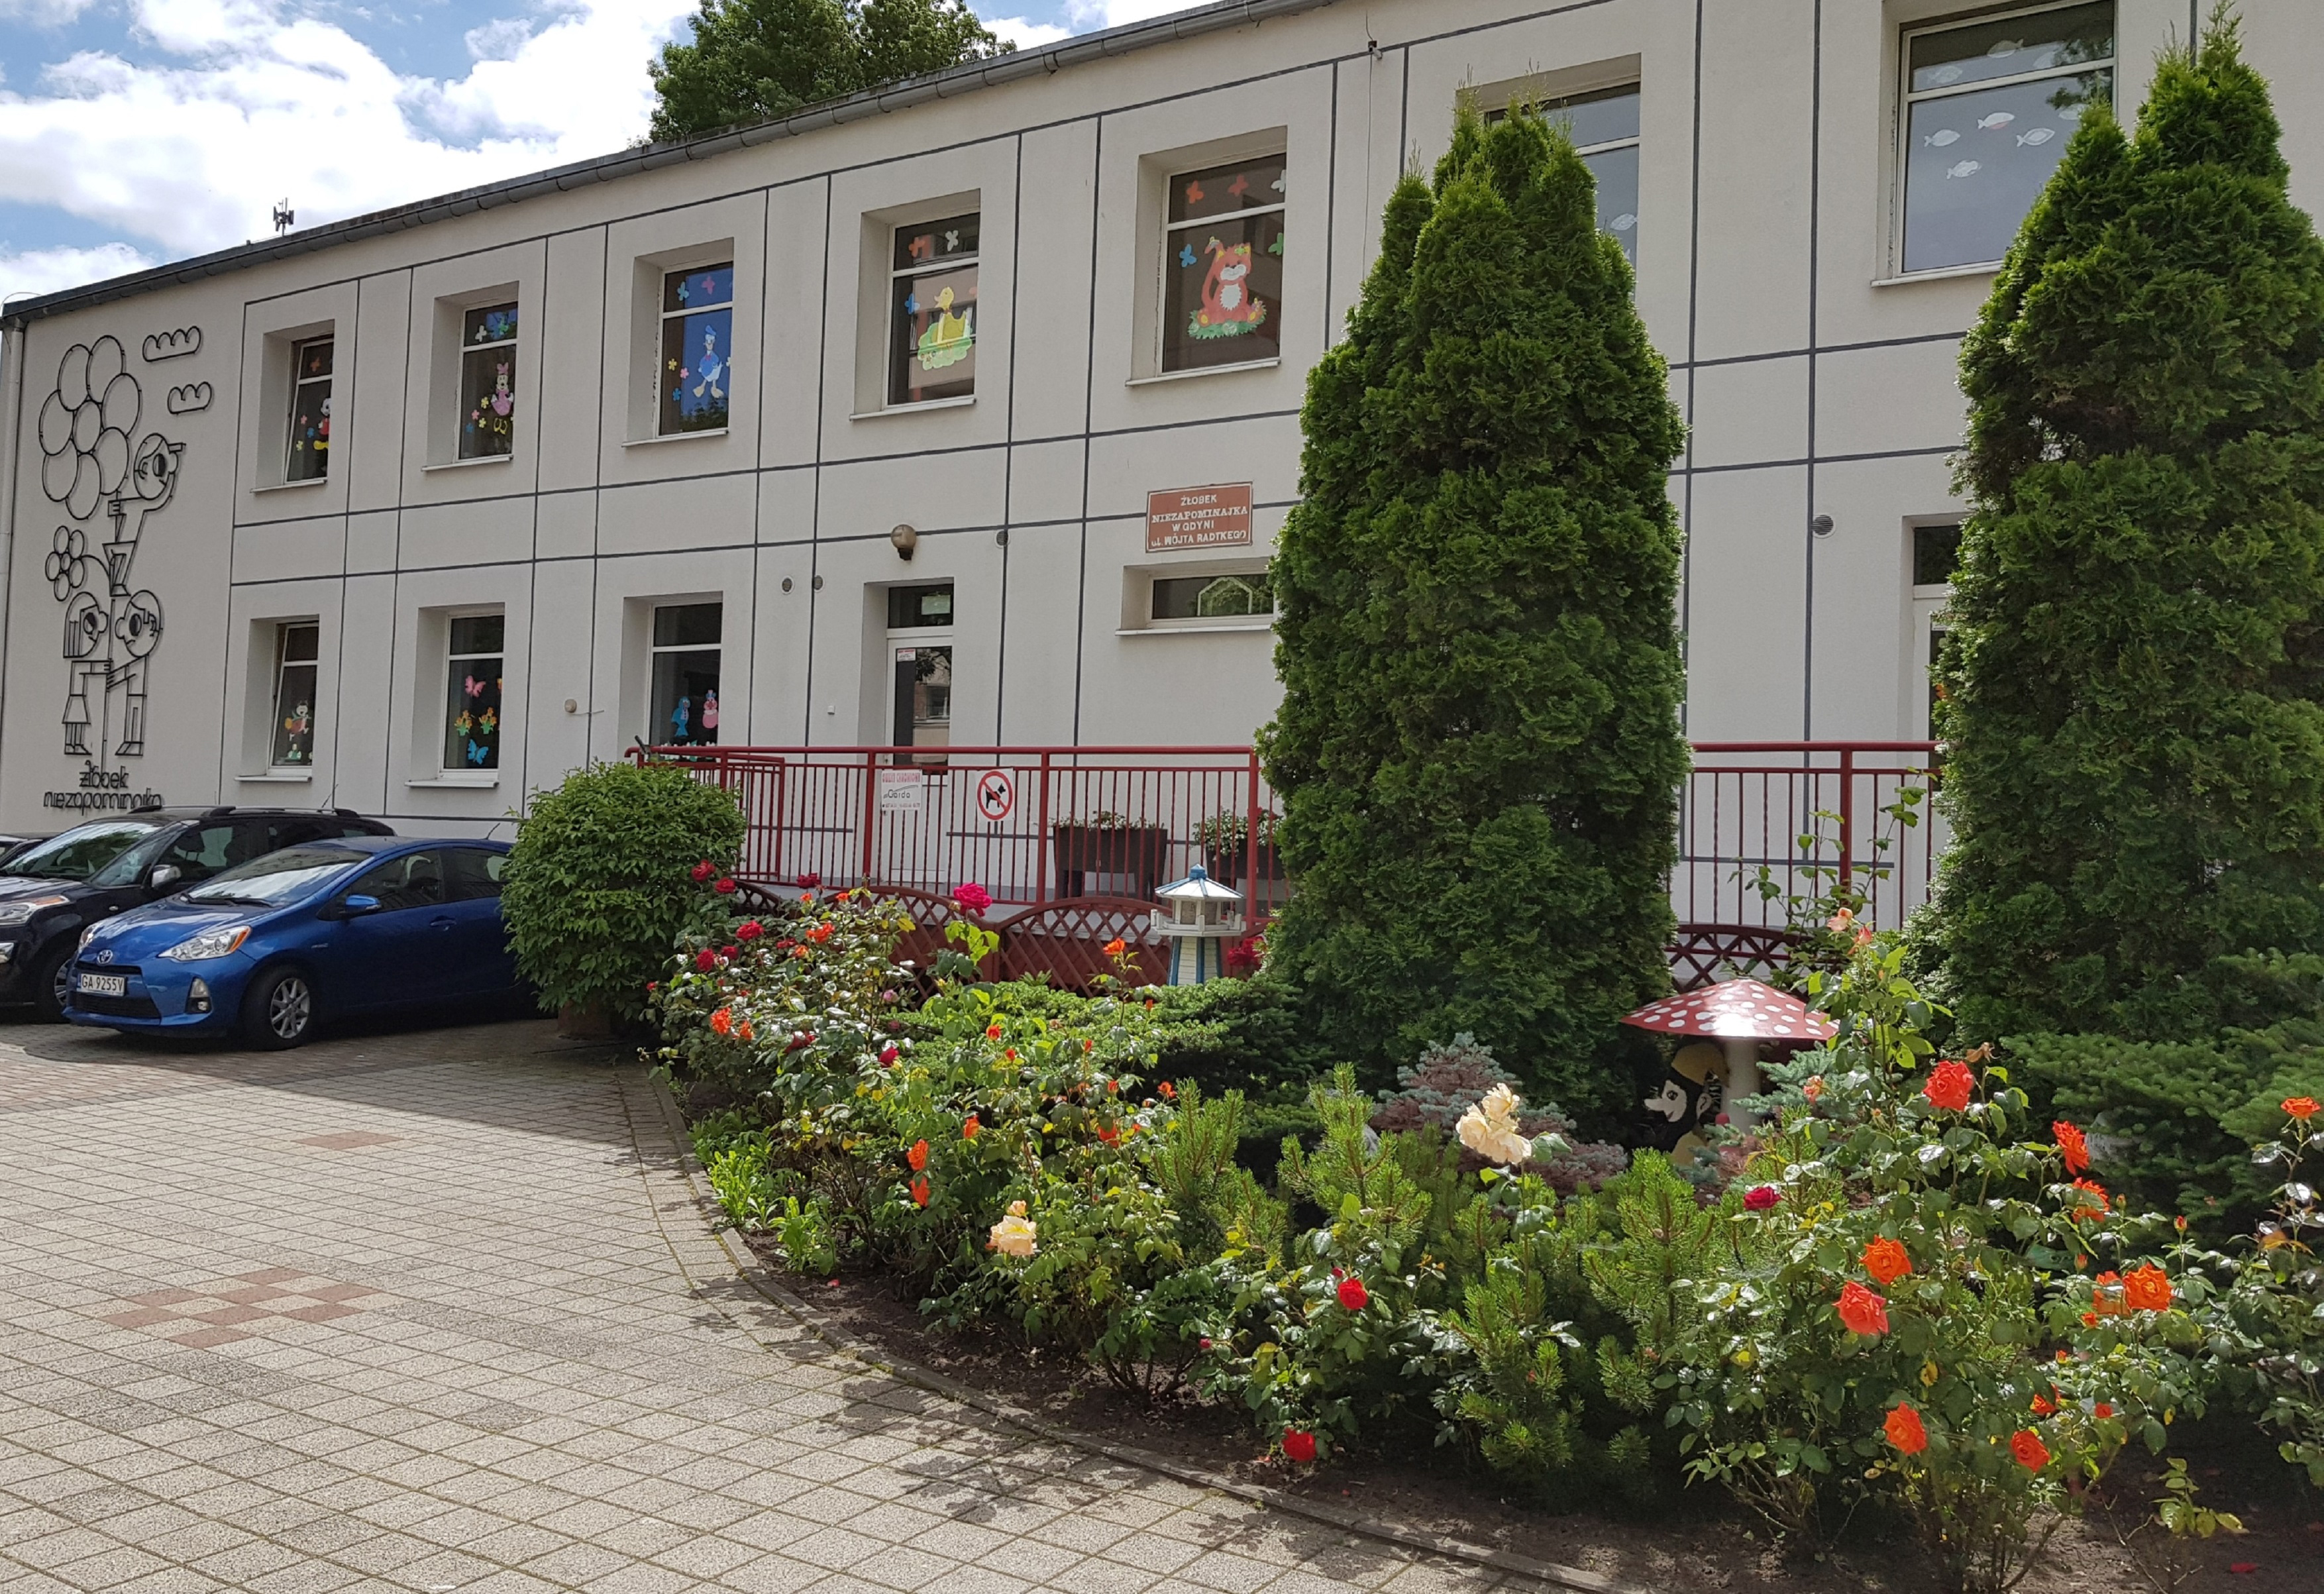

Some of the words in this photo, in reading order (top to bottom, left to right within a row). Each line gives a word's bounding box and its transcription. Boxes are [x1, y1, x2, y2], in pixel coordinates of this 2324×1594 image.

[1181, 494, 1218, 507] ŻŁOBEK
[1151, 505, 1248, 523] NIEZAPOMINAJKA
[1171, 523, 1181, 532] W
[1182, 519, 1214, 531] GDYNI
[1151, 537, 1163, 547] ul.
[1164, 533, 1194, 546] WÓJTA
[1197, 530, 1247, 543] RADTKEGO
[888, 788, 910, 799] Garda
[82, 975, 93, 989] GA
[96, 977, 123, 992] 9255V
